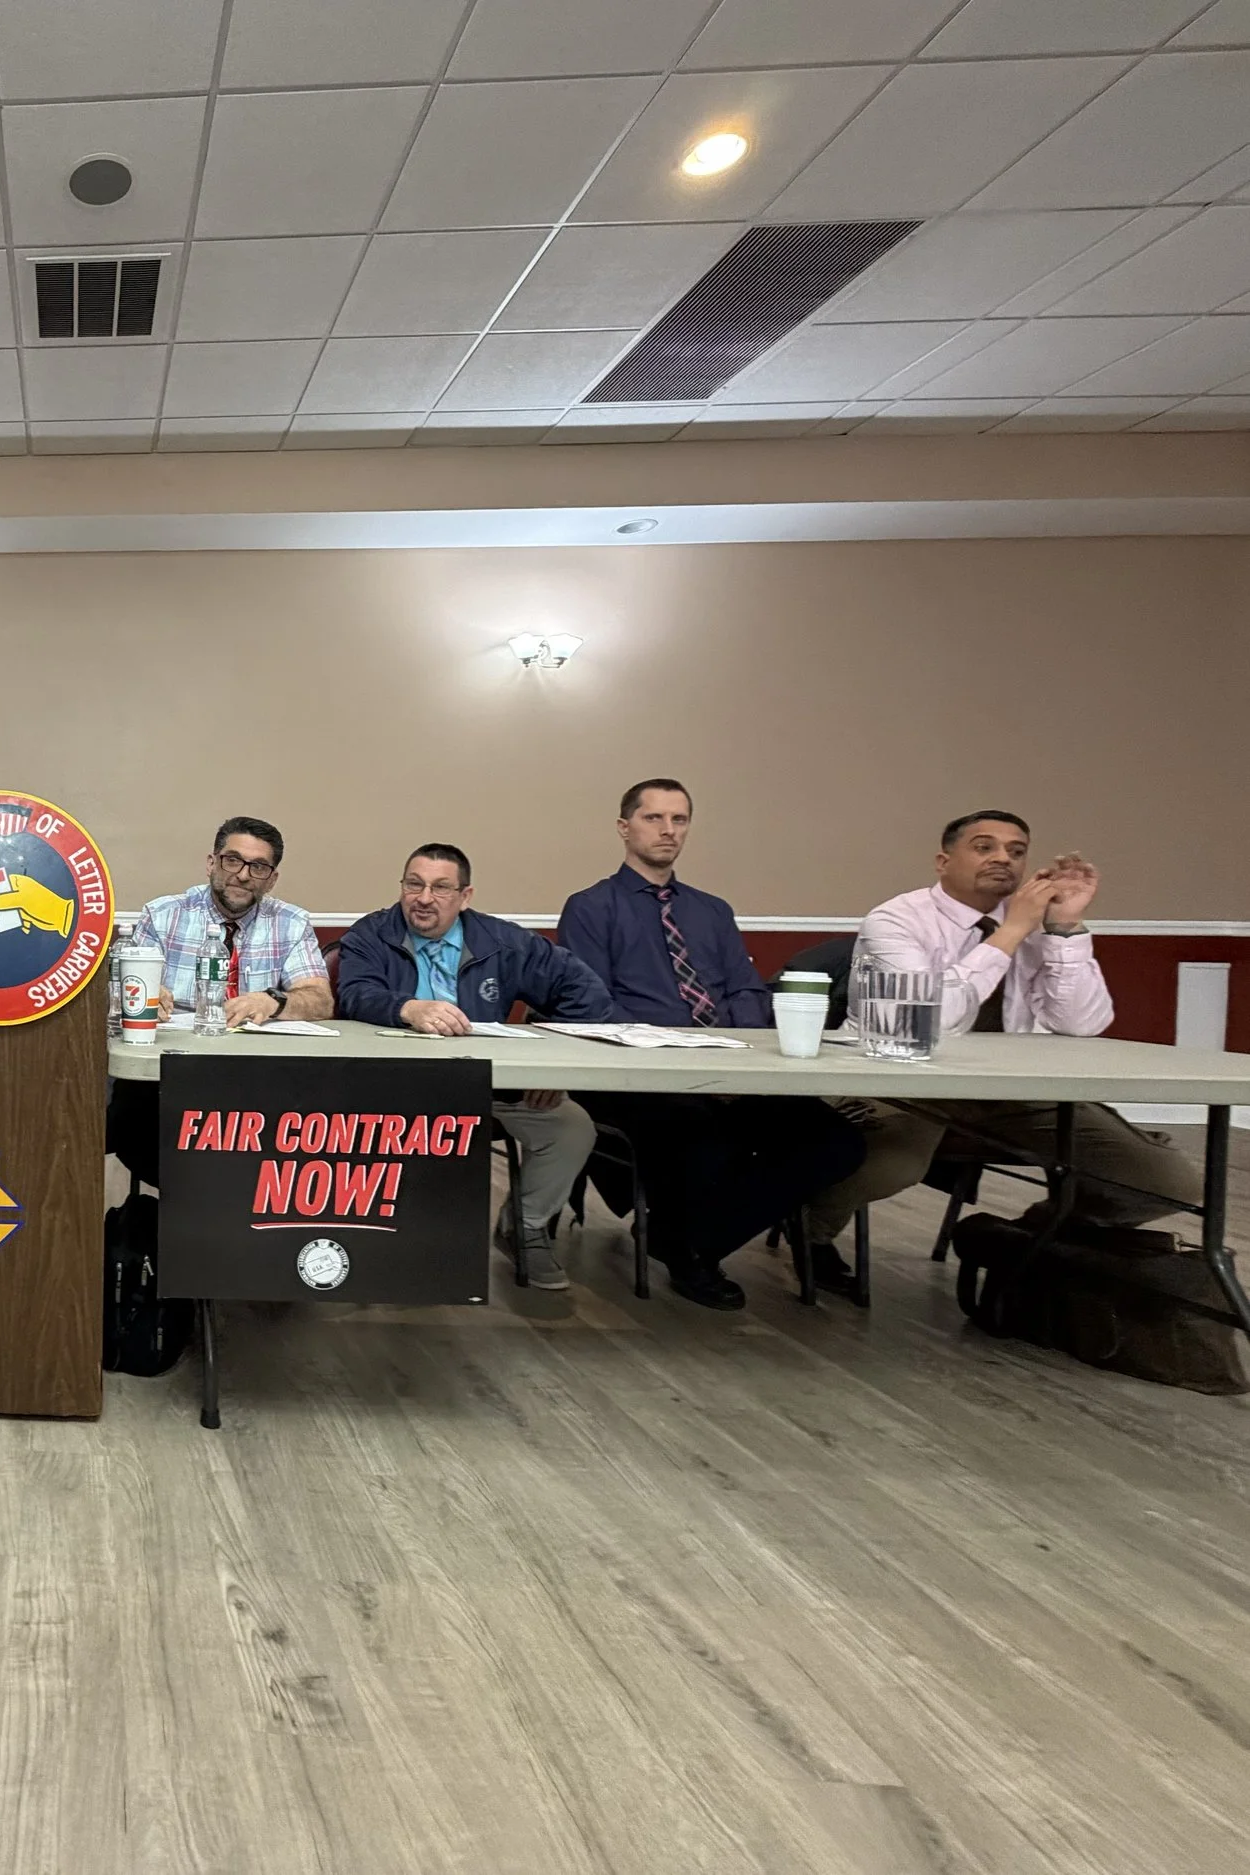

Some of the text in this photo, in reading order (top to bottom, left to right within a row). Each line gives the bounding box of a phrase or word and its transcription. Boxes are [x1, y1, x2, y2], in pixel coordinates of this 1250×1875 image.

[35, 813, 65, 839] OF
[68, 846, 105, 915] LETTER
[27, 931, 100, 1008] CARRIERS
[177, 1110, 481, 1156] FAIR CONTRACT
[252, 1159, 403, 1217] NOW!
